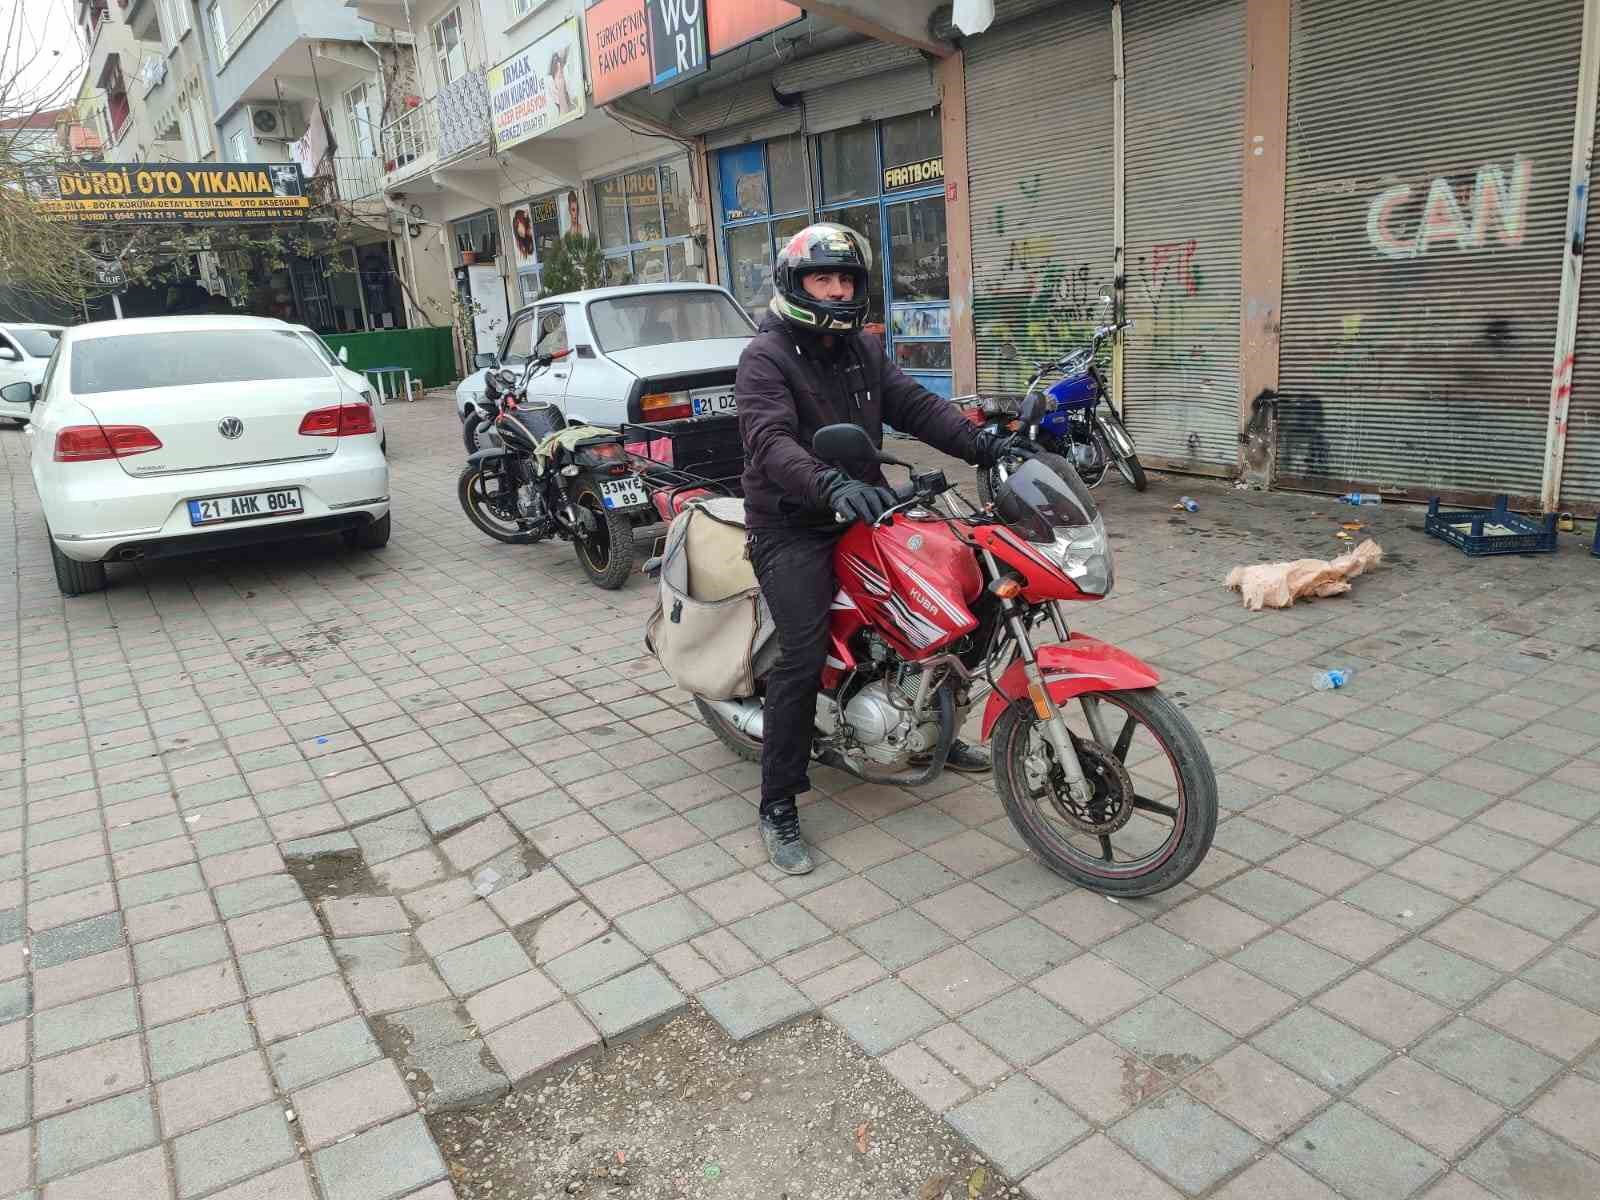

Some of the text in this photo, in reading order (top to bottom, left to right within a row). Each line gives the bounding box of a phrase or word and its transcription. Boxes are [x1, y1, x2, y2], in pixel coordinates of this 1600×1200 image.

[137, 171, 182, 194] OTO
[186, 171, 273, 193] YIKAMA
[1367, 153, 1533, 260] CAN
[700, 398, 713, 413] 21
[719, 394, 737, 409] DZ
[200, 491, 297, 519] 21 AHK 804
[622, 492, 639, 506] 89
